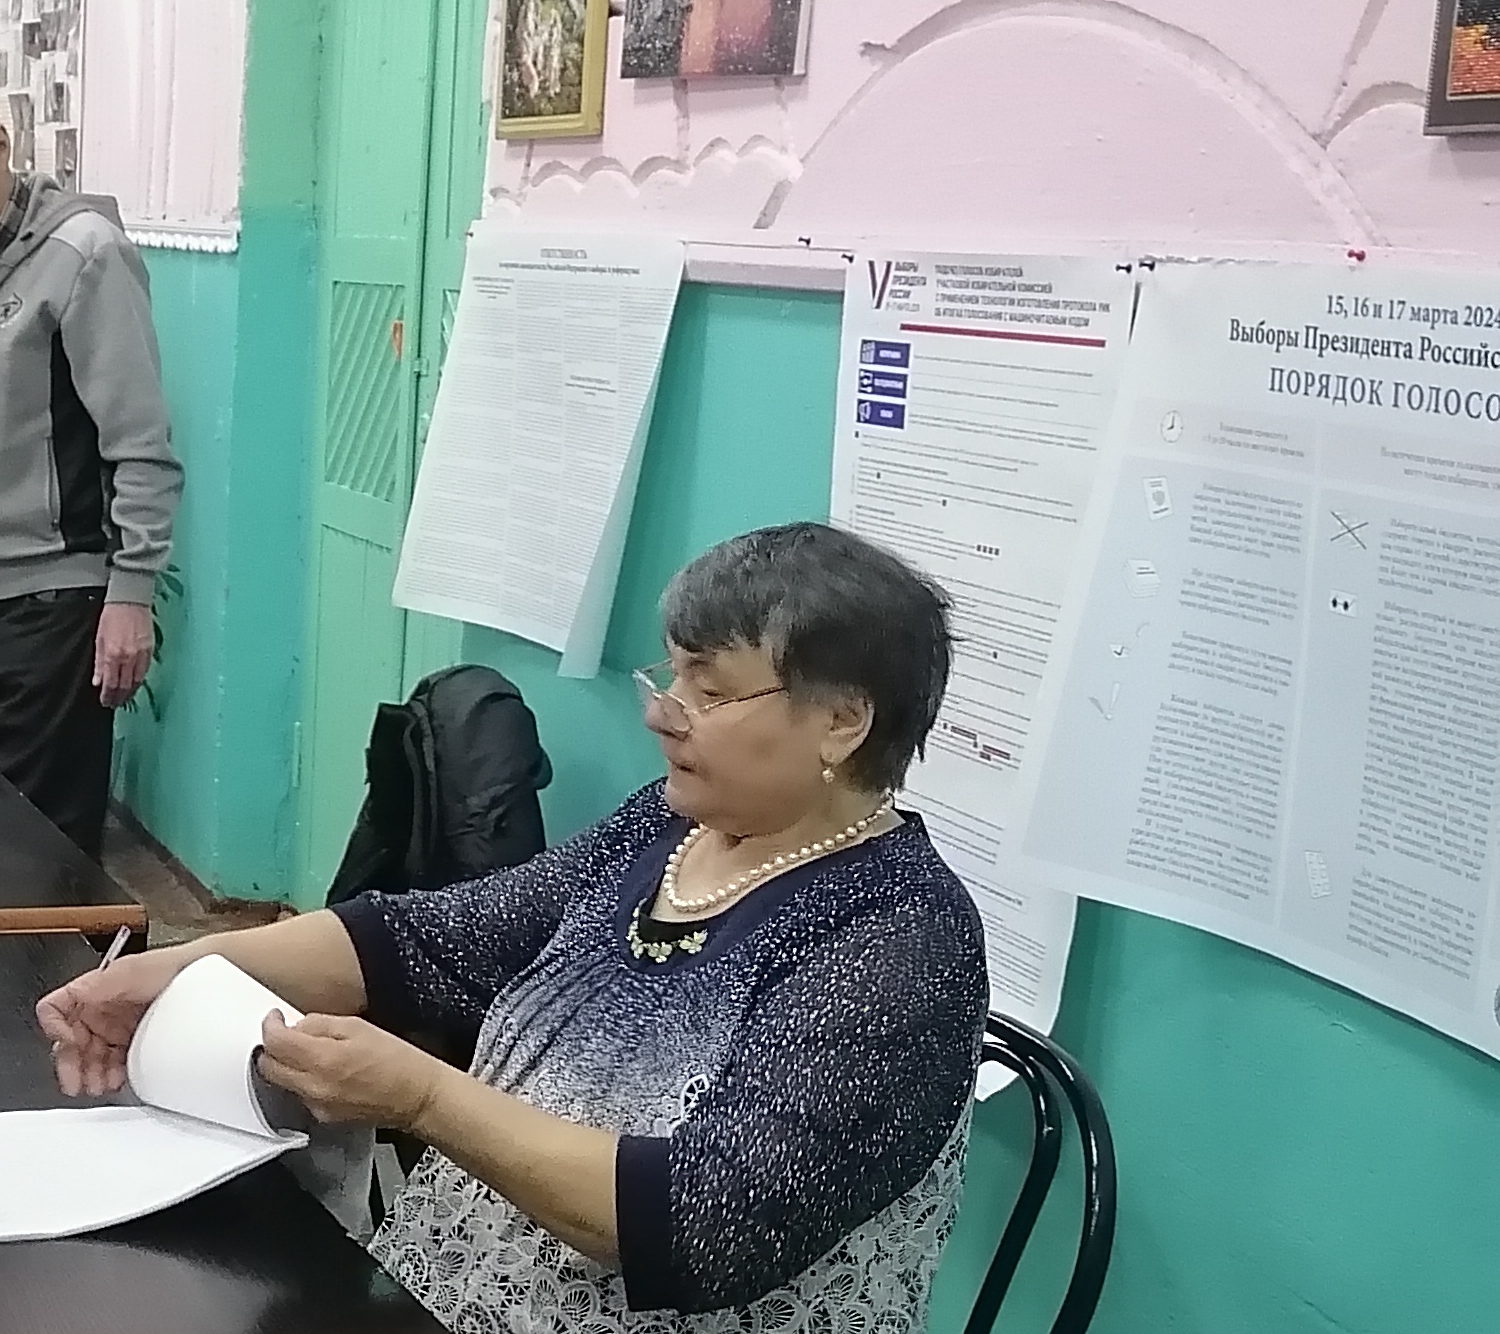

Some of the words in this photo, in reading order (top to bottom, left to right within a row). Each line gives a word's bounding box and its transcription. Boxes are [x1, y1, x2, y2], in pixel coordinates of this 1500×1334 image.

[1326, 294, 1348, 318] 15,
[1353, 296, 1369, 318] 16
[1373, 301, 1382, 319] и
[1388, 299, 1407, 320] 17
[1409, 304, 1459, 330] марта
[1228, 318, 1299, 353] Выборы
[1303, 325, 1413, 360] Президента
[1268, 367, 1383, 408] ПОРЯДОК
[1392, 382, 1500, 423] ГОЛОСО
